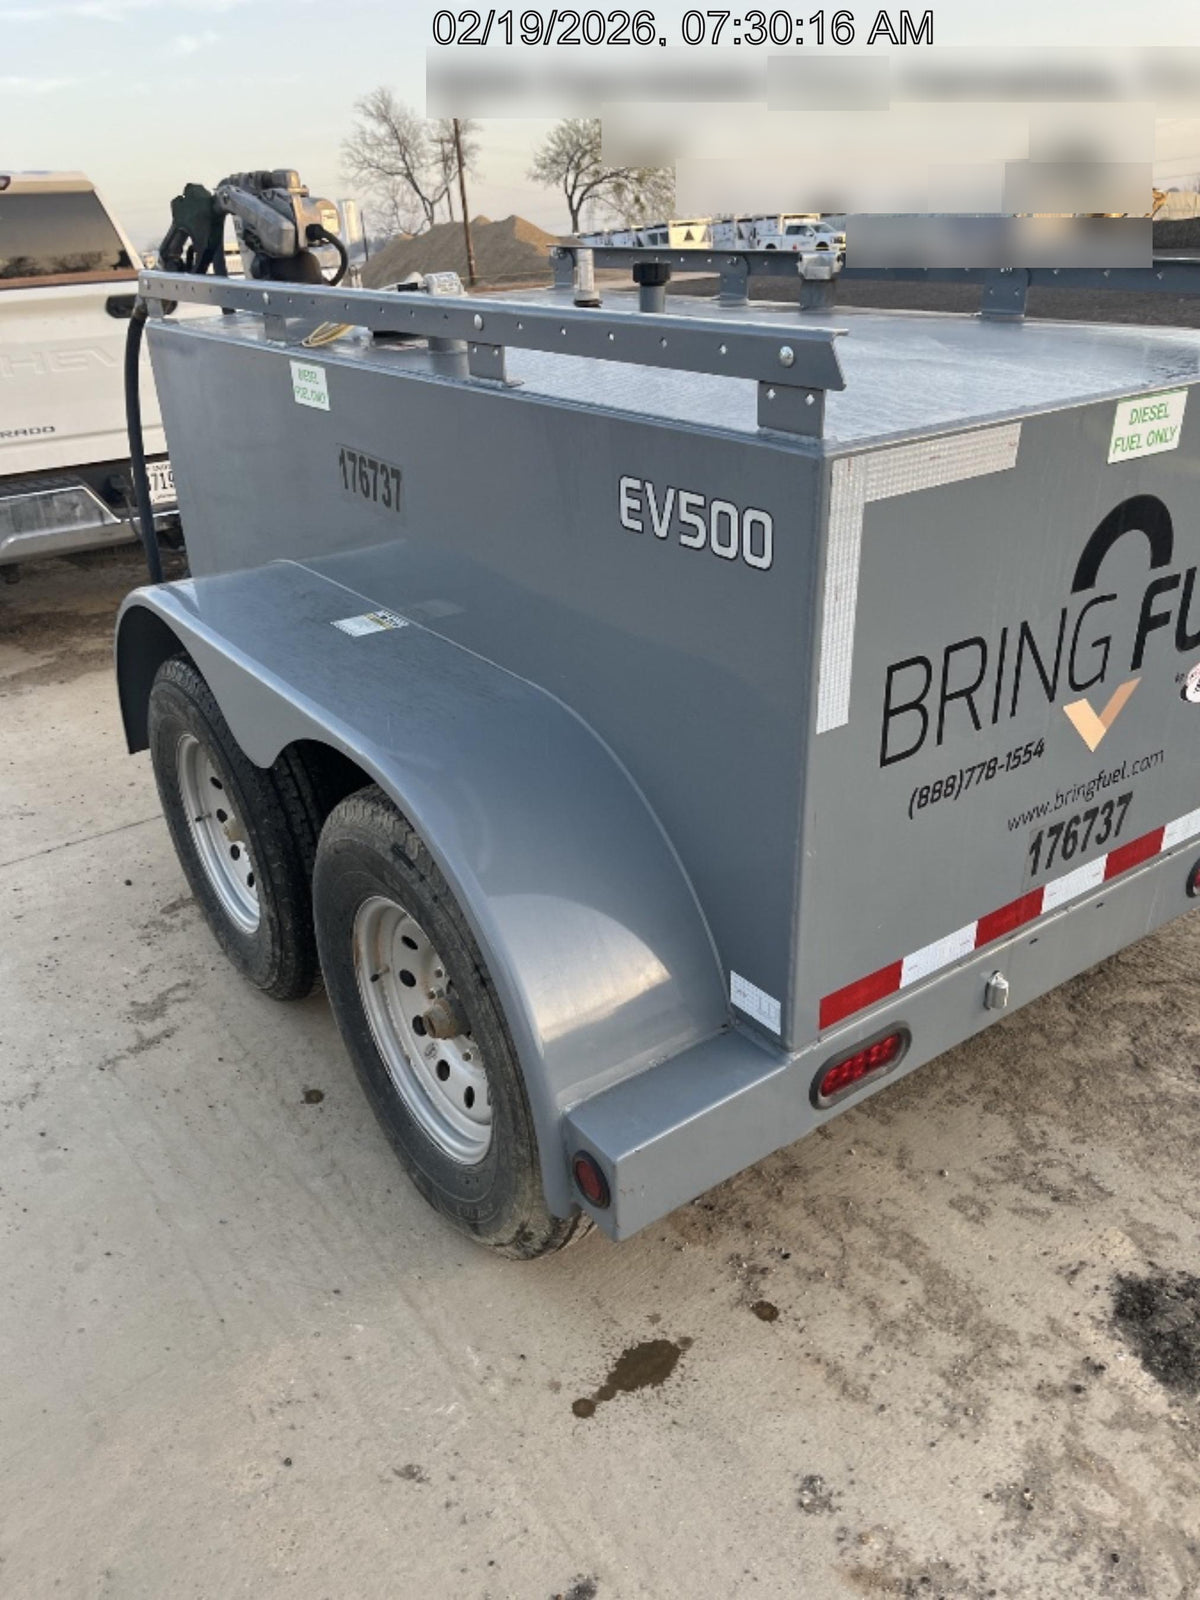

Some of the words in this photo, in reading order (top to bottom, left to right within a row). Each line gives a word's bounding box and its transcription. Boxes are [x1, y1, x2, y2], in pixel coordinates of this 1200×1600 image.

[1112, 433, 1143, 455] FUEL
[1146, 425, 1178, 447] ONLY
[1128, 402, 1169, 426] DIESEL
[338, 447, 403, 513] 176737
[618, 474, 774, 572] EV500
[880, 593, 1118, 768] BRING
[908, 737, 1046, 820] (888)778-1554
[1007, 749, 1165, 832] www.bringfuel.com
[1028, 790, 1134, 876] 176737
